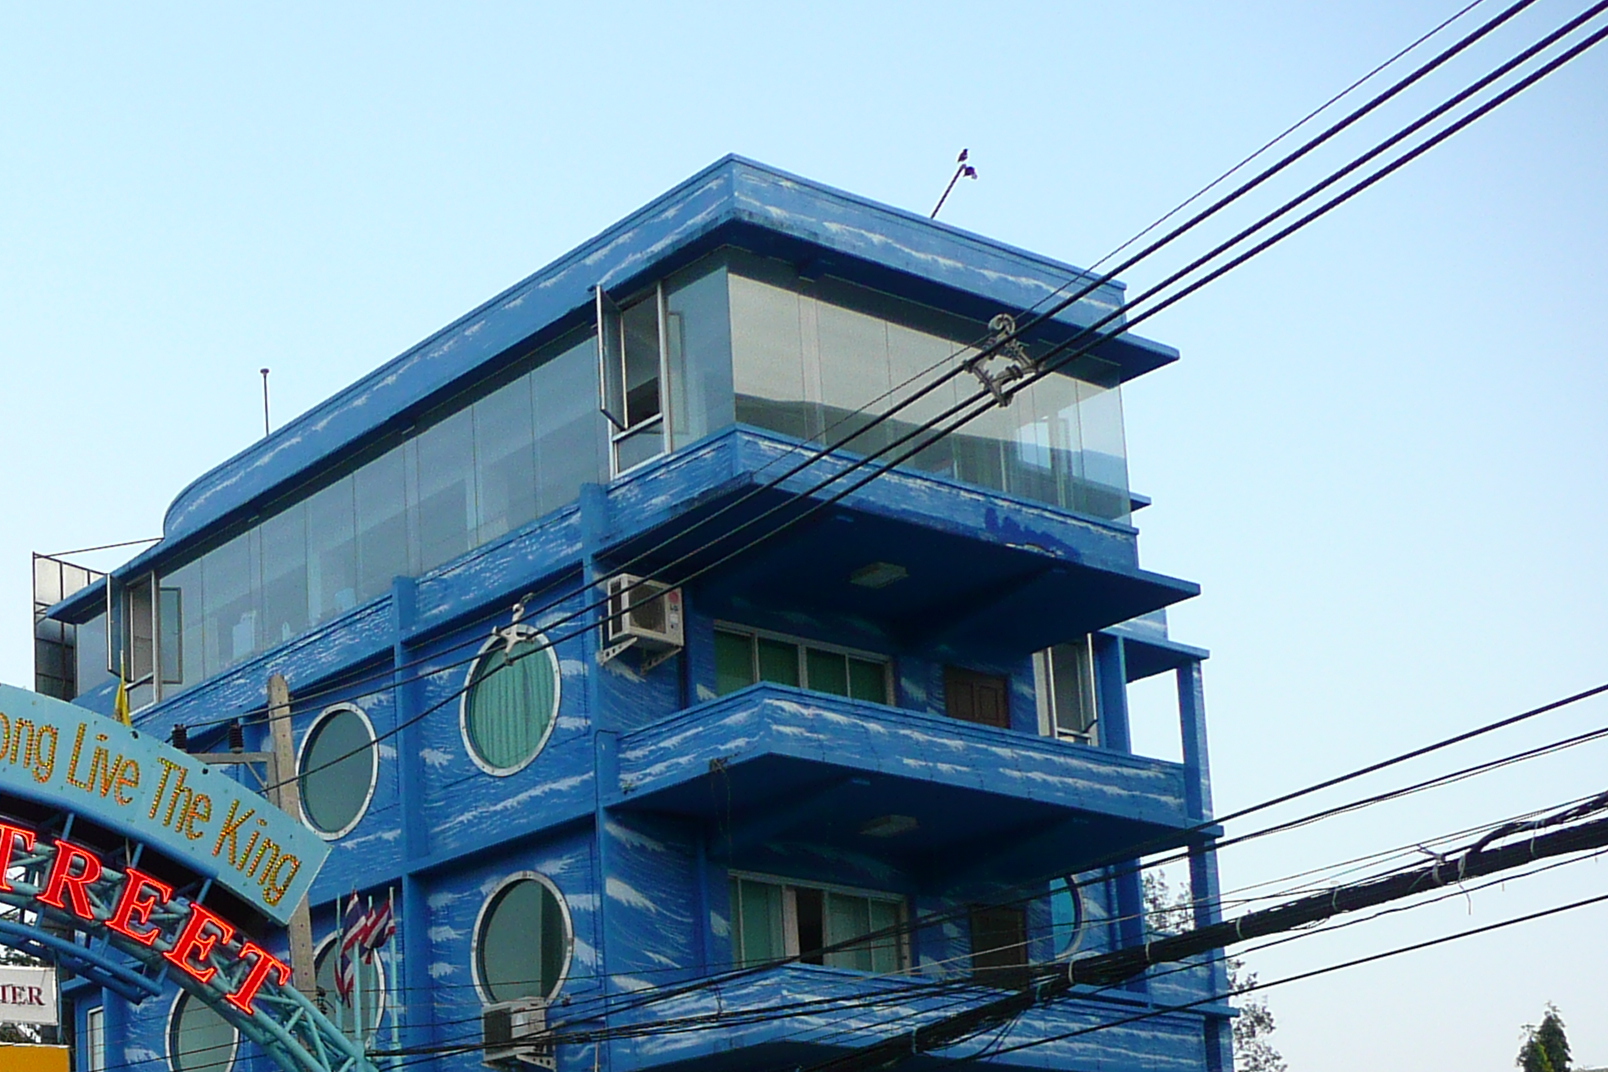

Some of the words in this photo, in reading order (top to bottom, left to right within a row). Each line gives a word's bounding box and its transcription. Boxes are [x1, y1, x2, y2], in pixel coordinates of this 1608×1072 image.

[66, 721, 140, 806] Live
[148, 756, 212, 841] The
[212, 798, 302, 907] King
